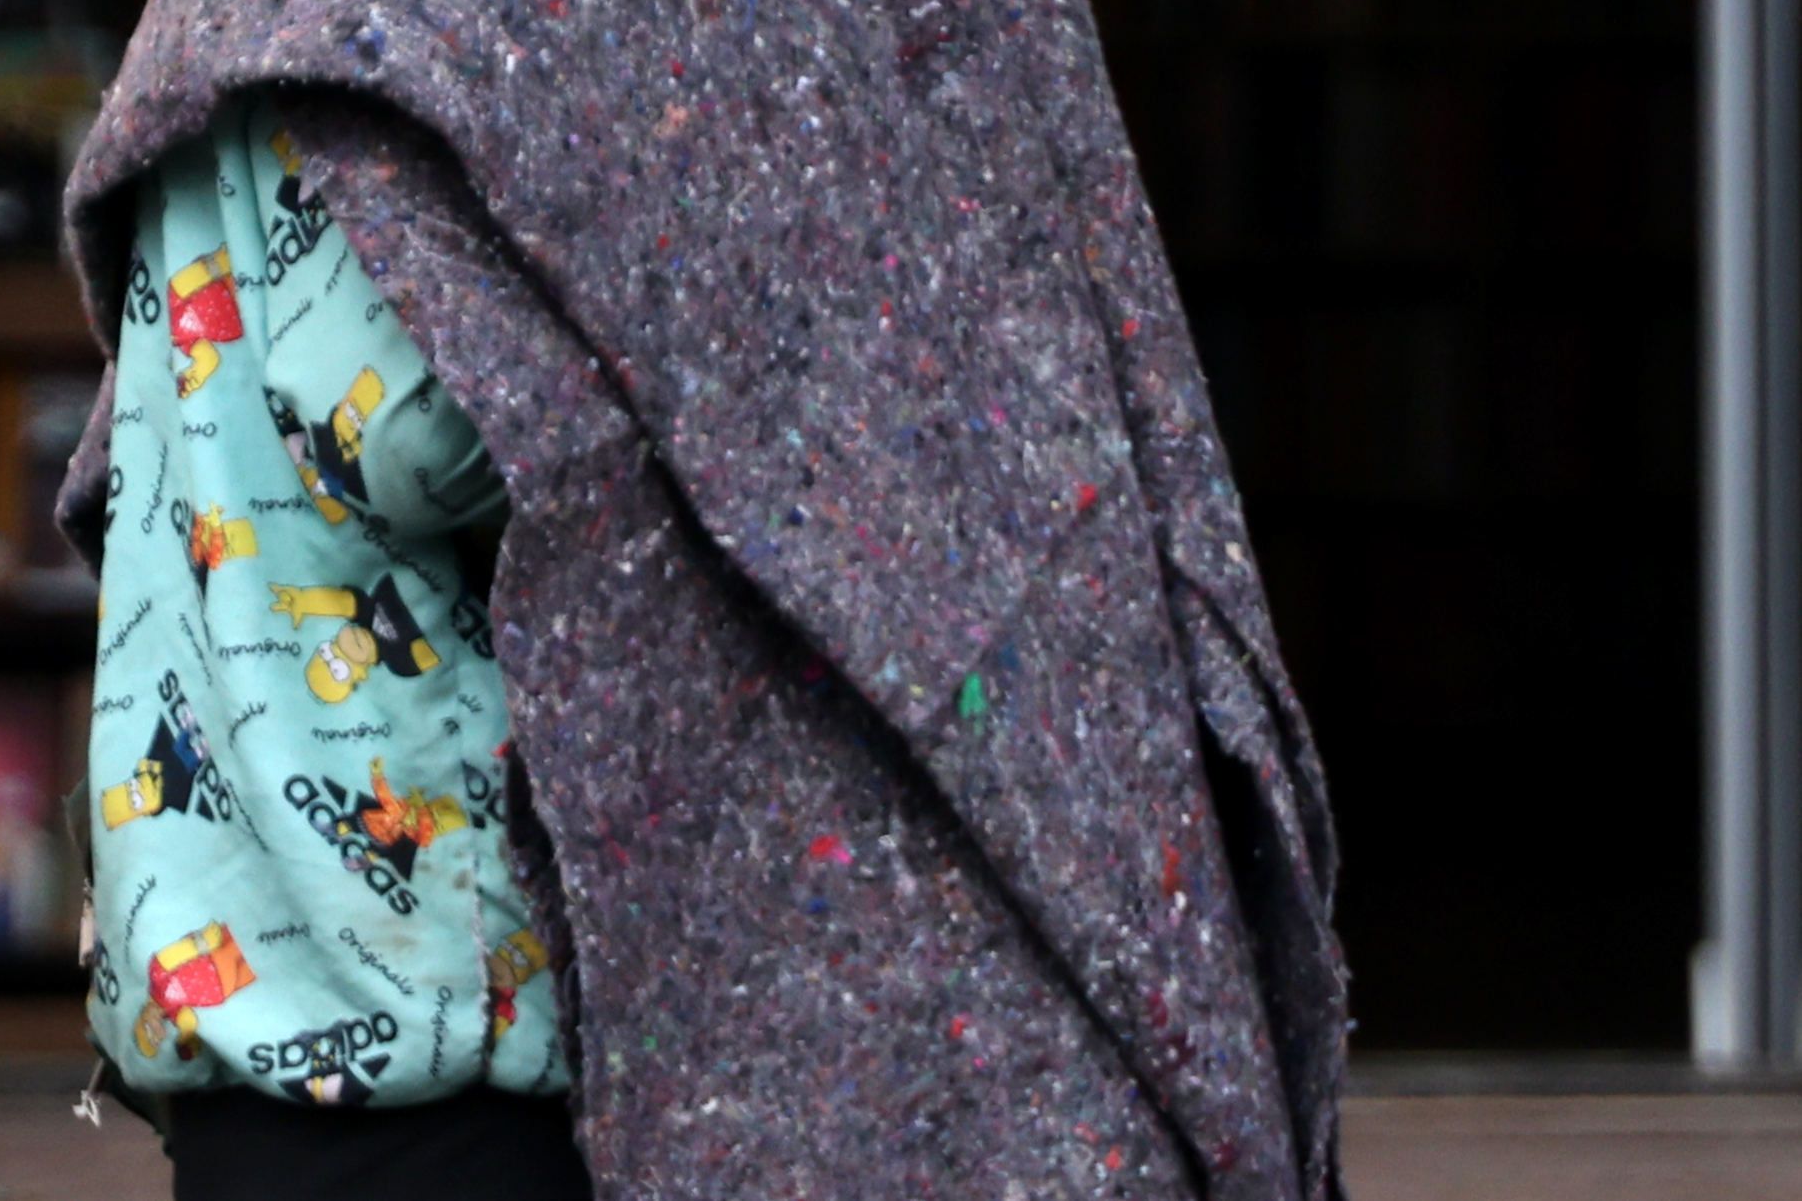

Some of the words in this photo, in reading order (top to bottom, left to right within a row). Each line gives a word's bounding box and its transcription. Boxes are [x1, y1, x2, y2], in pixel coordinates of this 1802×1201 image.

[99, 597, 151, 666] Originals
[219, 637, 301, 662] Originals
[158, 668, 232, 823] adas
[311, 721, 392, 744] Originals
[338, 926, 415, 997] Originals
[429, 984, 454, 1078] Originals
